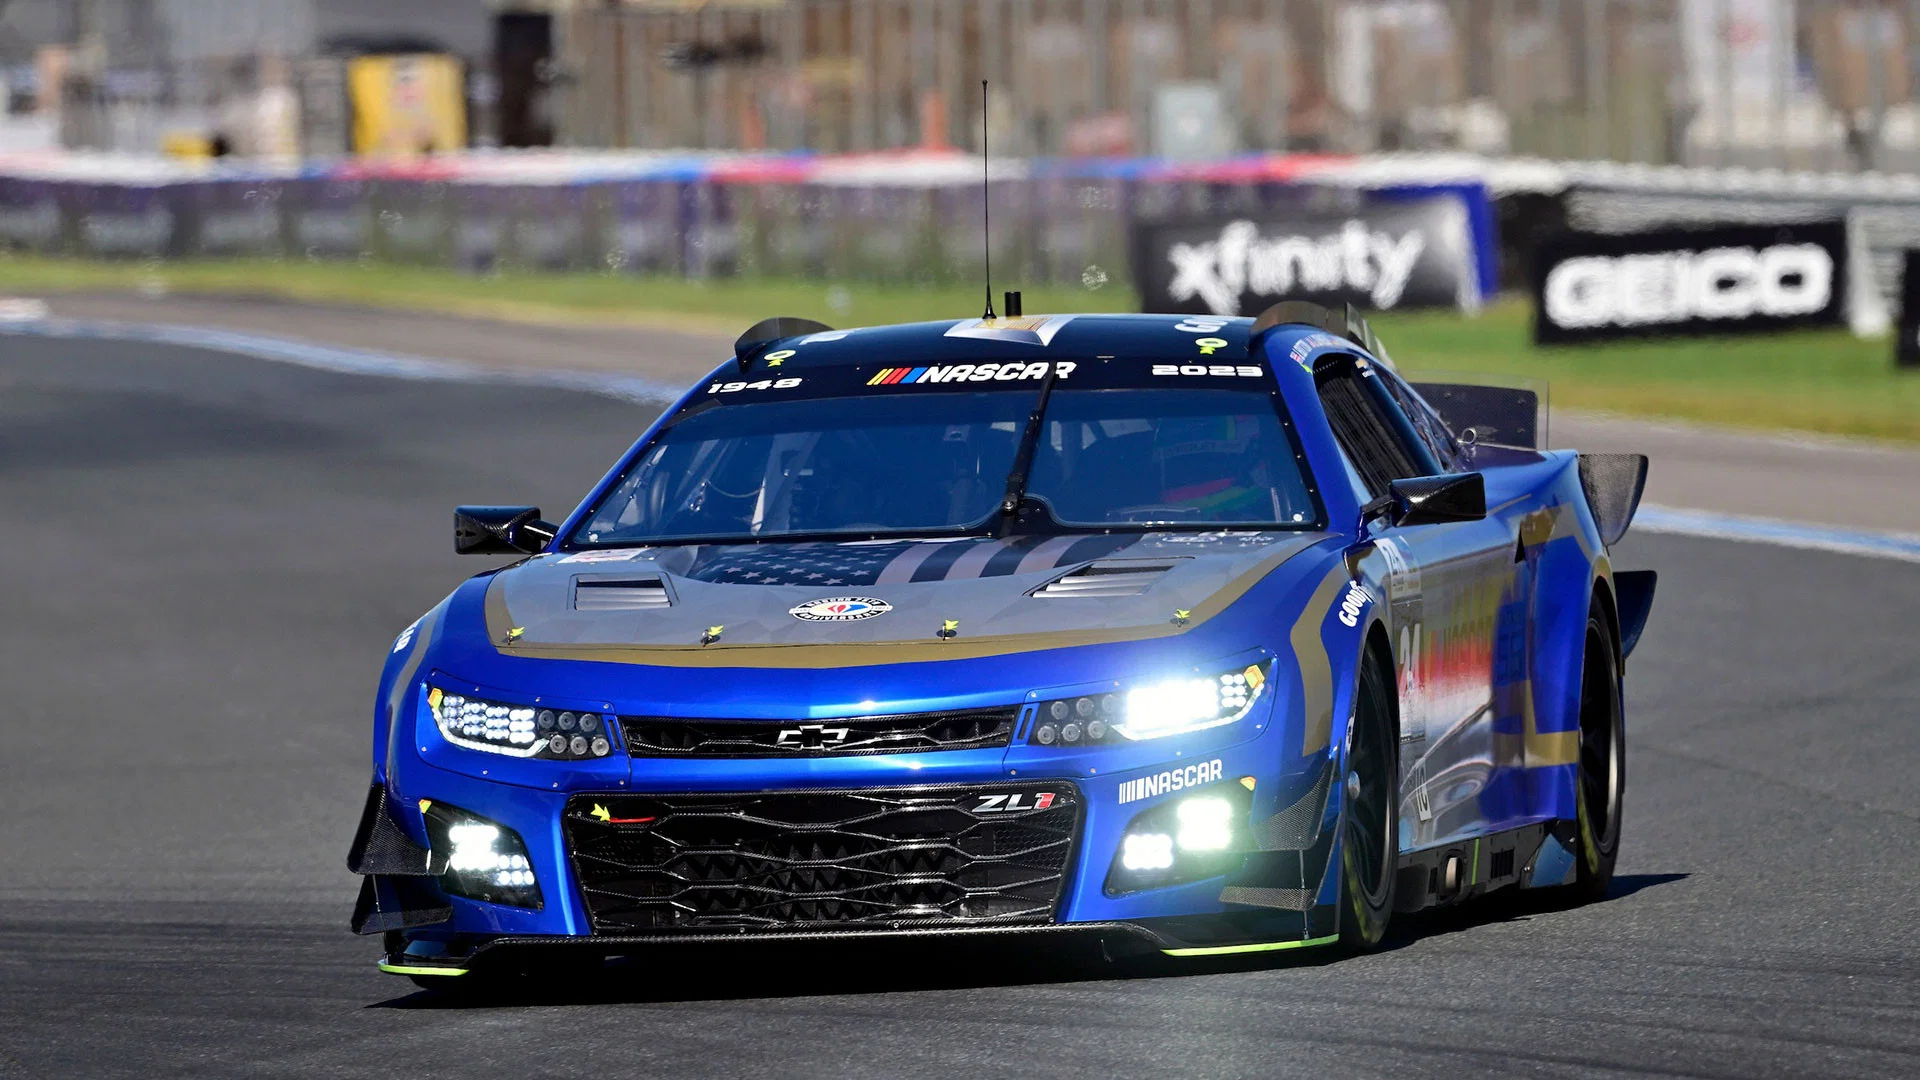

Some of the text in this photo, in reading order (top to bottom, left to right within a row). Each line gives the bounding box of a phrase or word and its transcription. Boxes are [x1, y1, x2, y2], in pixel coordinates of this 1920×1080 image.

[1168, 219, 1426, 316] xfinity
[1545, 243, 1833, 329] GEICO
[707, 377, 803, 394] 1948
[915, 361, 1077, 383] NASCAR
[1152, 364, 1264, 378] 2023
[1338, 580, 1377, 628] GOODY
[1144, 758, 1223, 798] NASCAR
[971, 792, 1056, 813] ZL1
